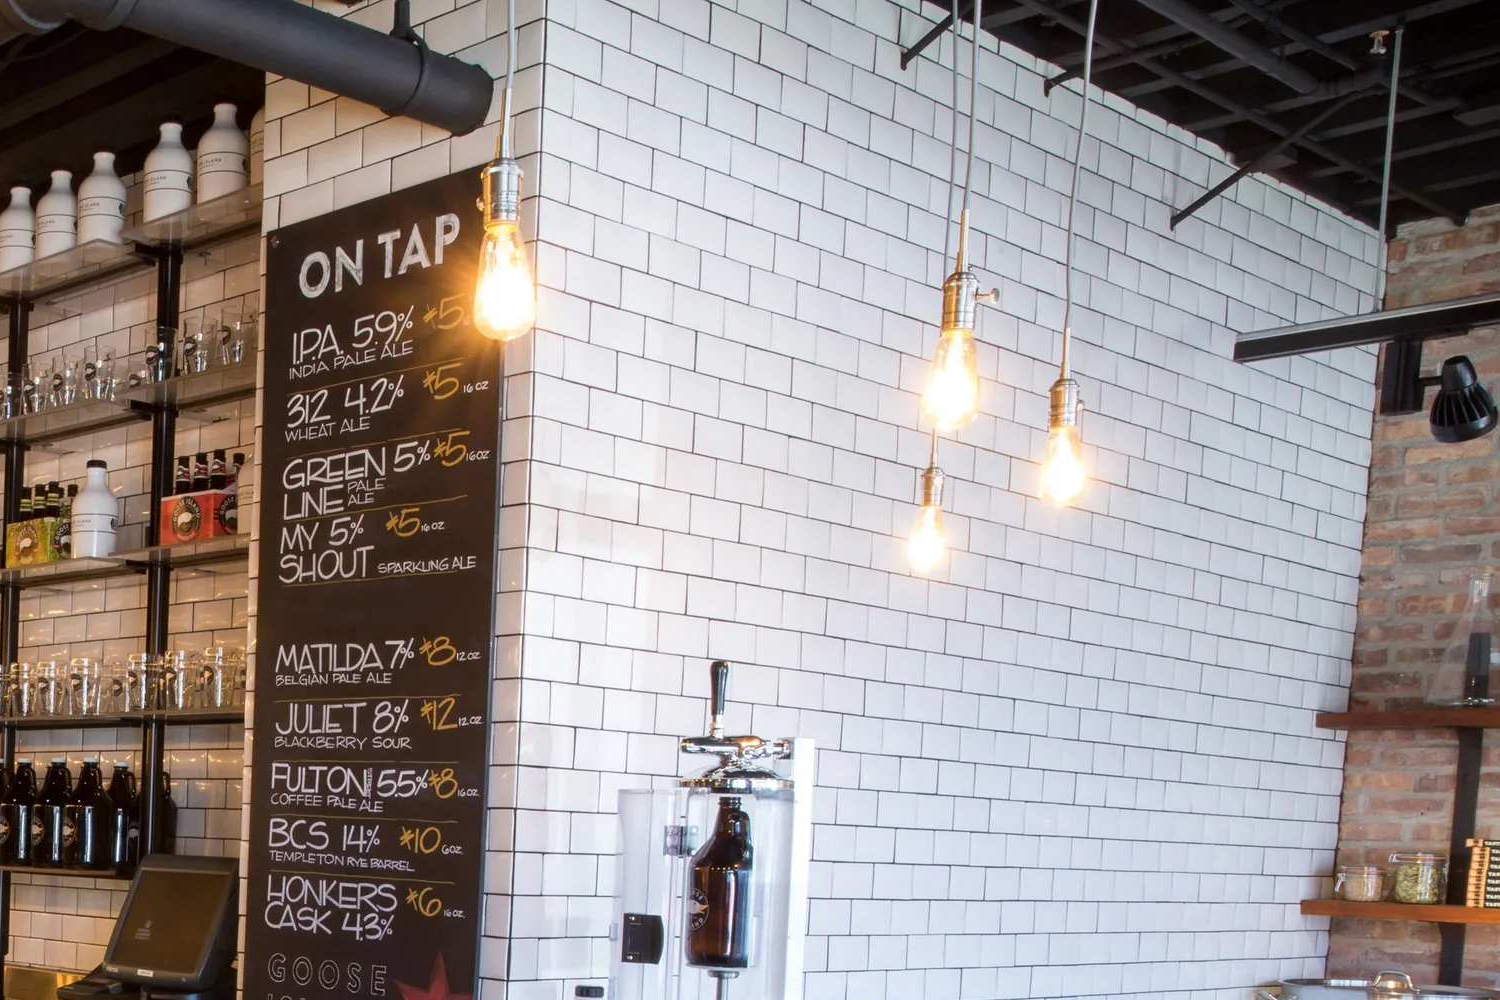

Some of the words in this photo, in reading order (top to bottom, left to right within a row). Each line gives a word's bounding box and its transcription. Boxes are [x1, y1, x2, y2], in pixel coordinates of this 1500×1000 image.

[299, 239, 364, 299] ON
[377, 213, 461, 279] TAP
[351, 304, 415, 349] 5.9%
[289, 361, 330, 380] INDIA
[333, 351, 377, 371] PALE
[380, 339, 414, 360] ALE
[287, 389, 331, 428] 312
[344, 374, 405, 415] 4.2%
[423, 362, 464, 400] $5
[463, 383, 474, 393] 16
[475, 380, 489, 391] OZ
[284, 421, 337, 442] WHEAT
[339, 415, 371, 435] ALE
[282, 446, 387, 490] GREEN
[393, 439, 431, 473] 5%
[433, 430, 471, 467] $5
[283, 484, 344, 521] LINE
[348, 477, 386, 493] PALE
[348, 493, 375, 507] ALE
[280, 522, 320, 554] MY
[329, 513, 364, 546] 5%
[385, 507, 420, 537] $5
[421, 522, 430, 532] 16
[278, 545, 375, 584] SHOUT
[377, 556, 449, 574] SPARKLING
[451, 555, 477, 571] ALE
[275, 642, 383, 675] MATILDA
[385, 637, 415, 669] 7%
[418, 635, 457, 666] $8
[275, 672, 329, 686] BELGIAN
[332, 673, 361, 684] PALE
[366, 672, 392, 684] ALE
[275, 702, 367, 735] JULIET
[372, 699, 409, 734] 8%
[420, 697, 458, 731] $12
[274, 736, 368, 751] BLACKBERRY
[372, 737, 412, 750] SOUR
[270, 763, 367, 797] FULTON
[376, 769, 429, 797] 5.5%
[428, 768, 458, 799] $8
[270, 792, 324, 807] COFFEE
[327, 794, 357, 809] PALE
[359, 800, 383, 813] ALE
[268, 818, 330, 850] BCS
[342, 825, 380, 853] 14%
[399, 825, 442, 854] $10
[269, 850, 345, 867] TEMPLETON
[347, 857, 369, 869] RYE
[370, 858, 415, 872] BARREL
[267, 874, 398, 913] HONKERS
[405, 886, 442, 917] $6
[264, 901, 332, 935] CASK
[342, 912, 395, 941] 4.3%
[267, 952, 388, 997] GOOSE
